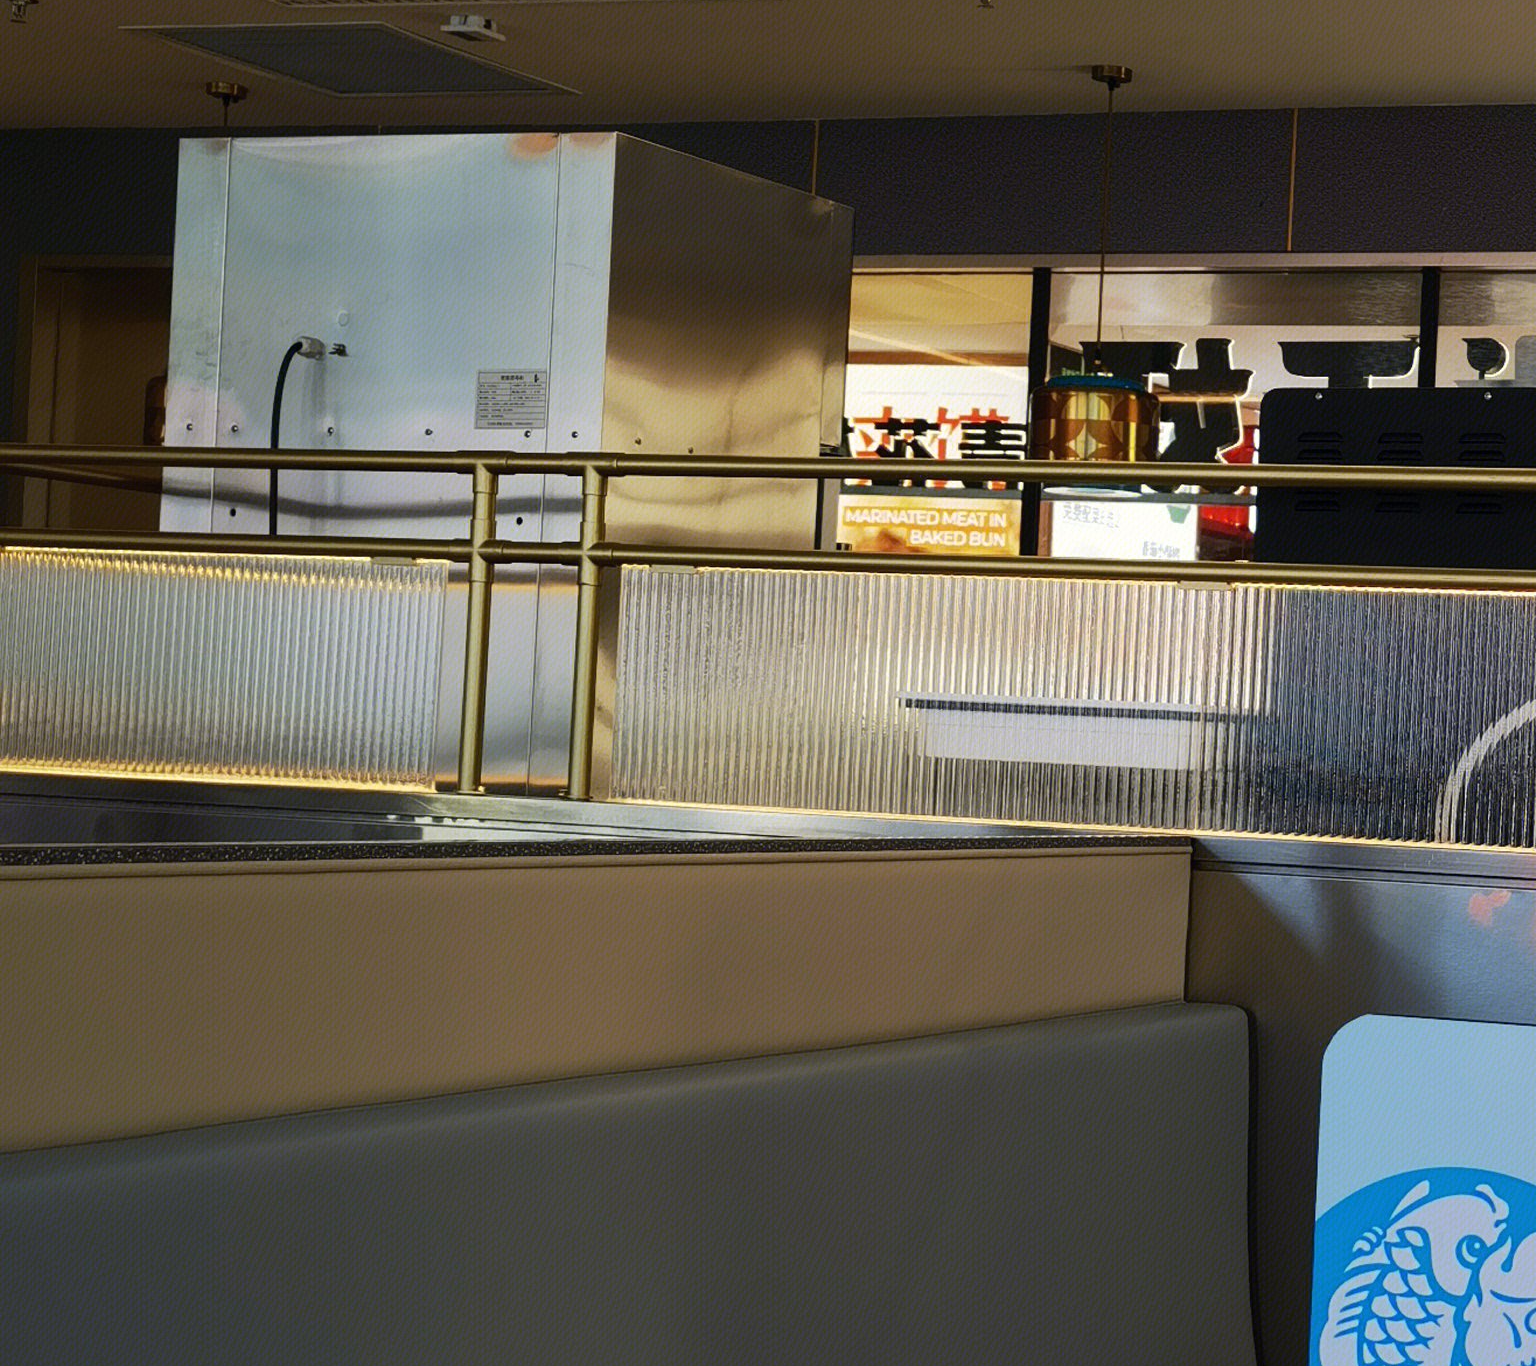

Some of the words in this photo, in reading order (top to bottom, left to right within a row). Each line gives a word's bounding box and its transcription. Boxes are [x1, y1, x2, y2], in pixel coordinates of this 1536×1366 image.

[845, 507, 940, 526] MARINATED
[942, 510, 986, 527] MEAT
[988, 511, 1007, 527] IN
[909, 530, 965, 546] BAKED
[969, 530, 1006, 548] BUN
